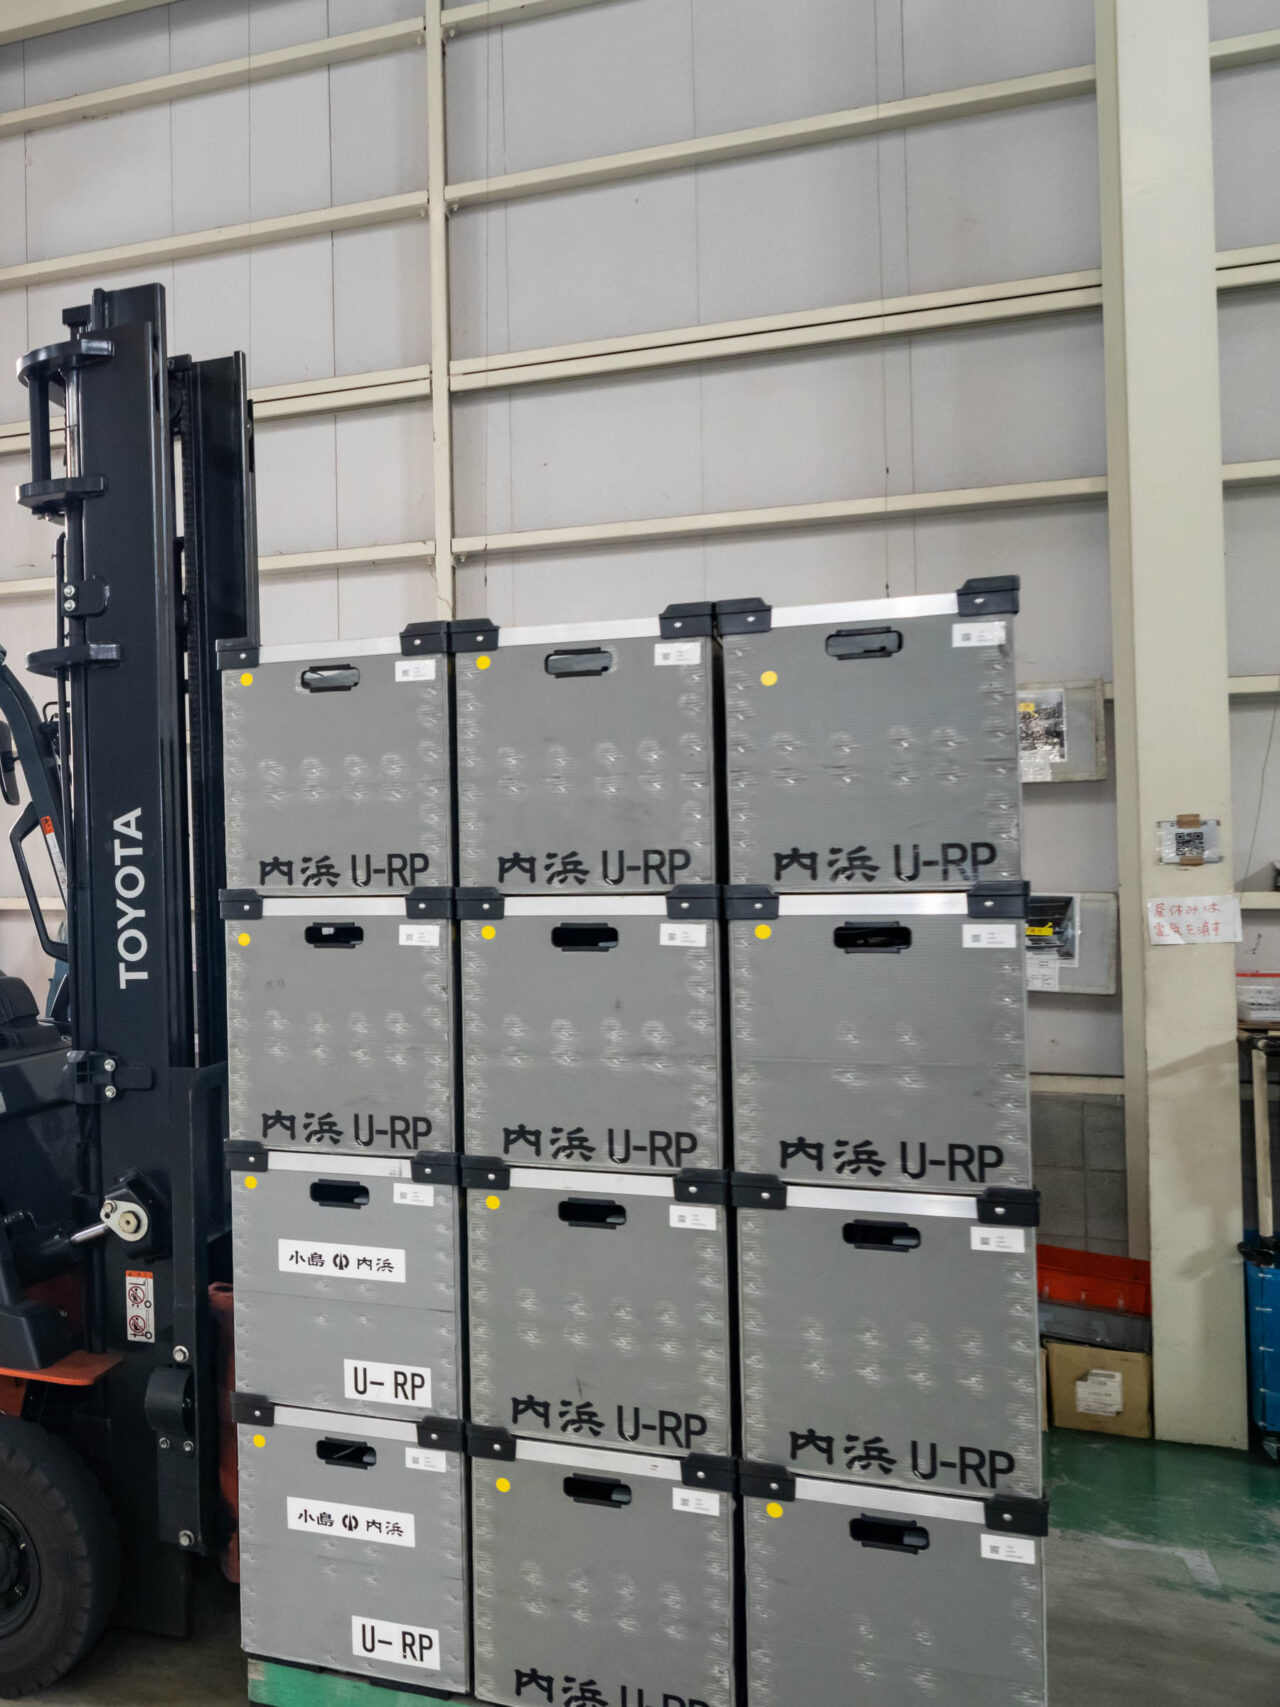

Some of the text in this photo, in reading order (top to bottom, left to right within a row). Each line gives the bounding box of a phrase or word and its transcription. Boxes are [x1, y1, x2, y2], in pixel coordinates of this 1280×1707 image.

[260, 853, 429, 887] 内浜 U-RP
[498, 849, 691, 885] 内浜 U-RP
[774, 842, 996, 881] 内浜 U-RP
[113, 807, 148, 990] TOYOTA
[261, 1110, 432, 1150] 内浜 U-RP
[503, 1124, 698, 1167] 内浜 U-RP
[780, 1137, 1003, 1183] 内浜 U-RP
[289, 1251, 394, 1273] 小島 内浜
[511, 1395, 707, 1449] 内浜 U-RP
[789, 1429, 1014, 1489] 内浜 U-RP
[298, 1509, 404, 1537] 小島 内浜
